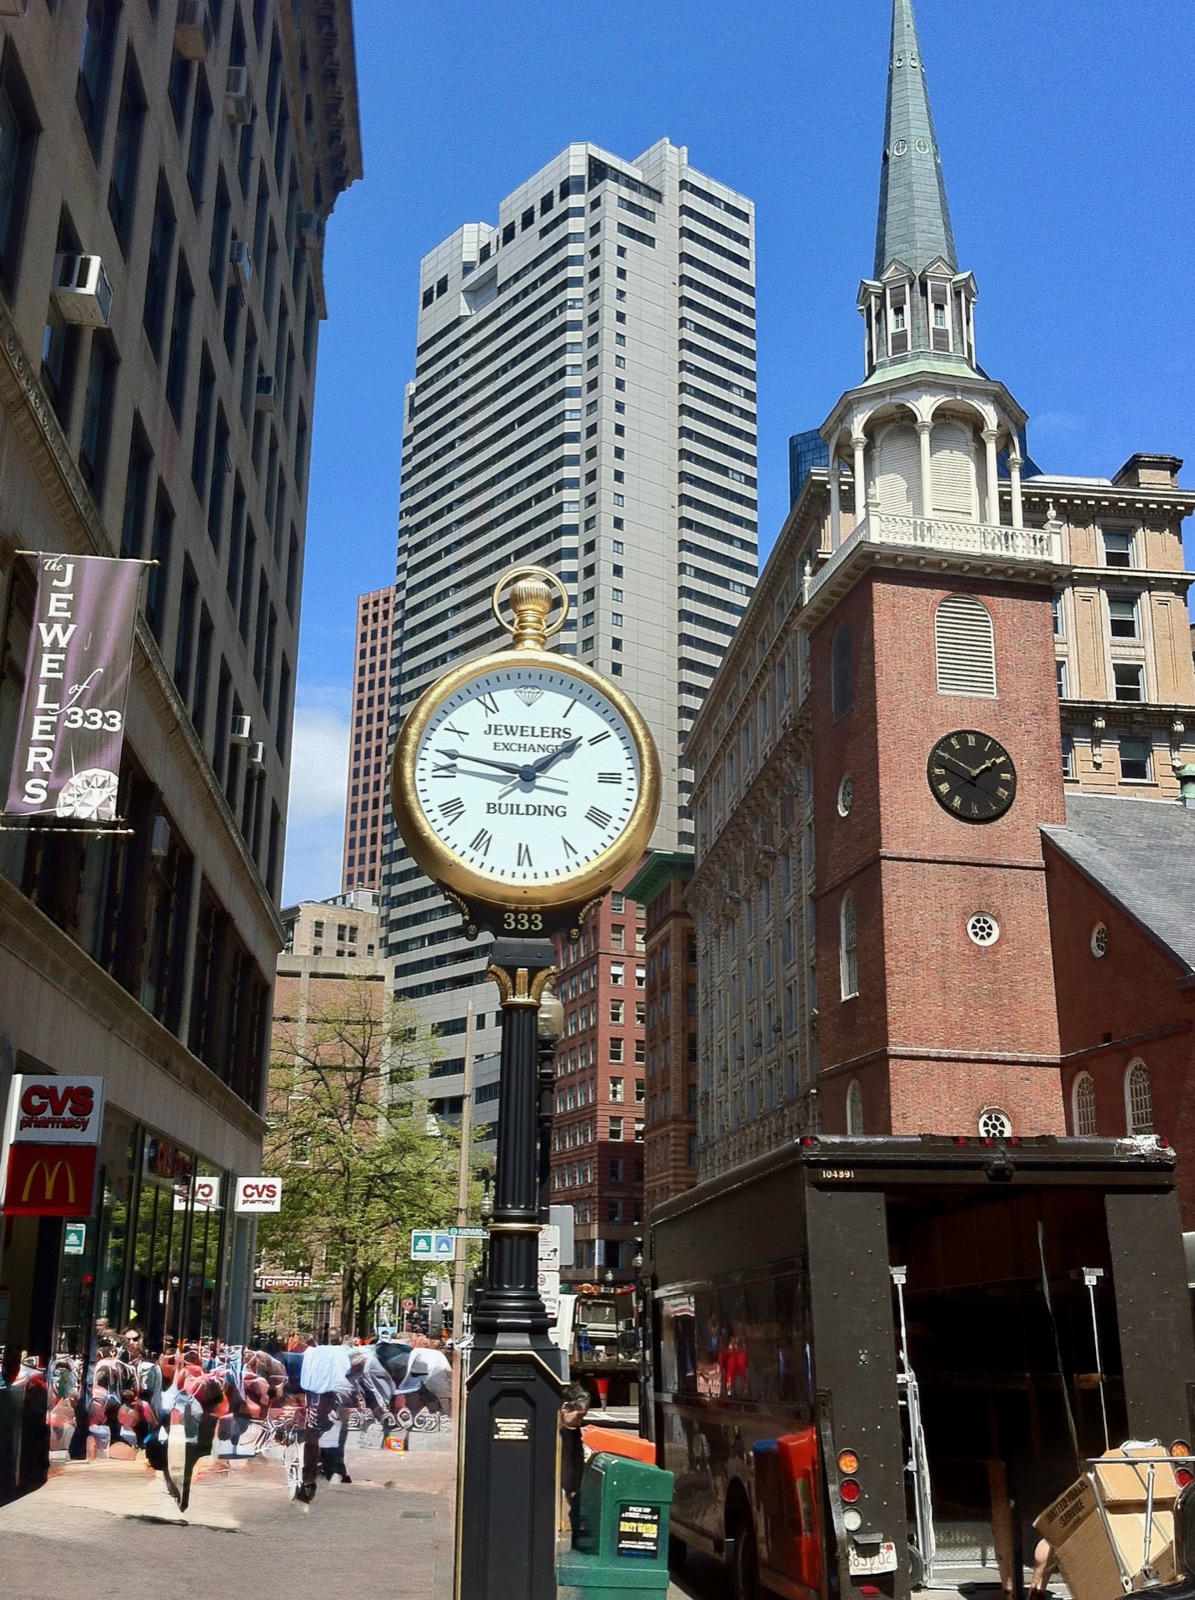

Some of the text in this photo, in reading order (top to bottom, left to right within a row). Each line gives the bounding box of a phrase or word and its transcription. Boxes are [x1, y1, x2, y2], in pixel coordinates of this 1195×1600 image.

[42, 554, 67, 571] The
[22, 563, 78, 805] JEWELERS
[48, 667, 104, 716] of
[62, 706, 123, 732] 333
[483, 723, 572, 740] JEWELERS
[486, 801, 568, 818] BUILDING
[503, 912, 543, 931] 333
[21, 1084, 95, 1117] CVS
[19, 1114, 91, 1132] pharmacy
[242, 1183, 278, 1199] CVS
[242, 1198, 277, 1206] pharmacy
